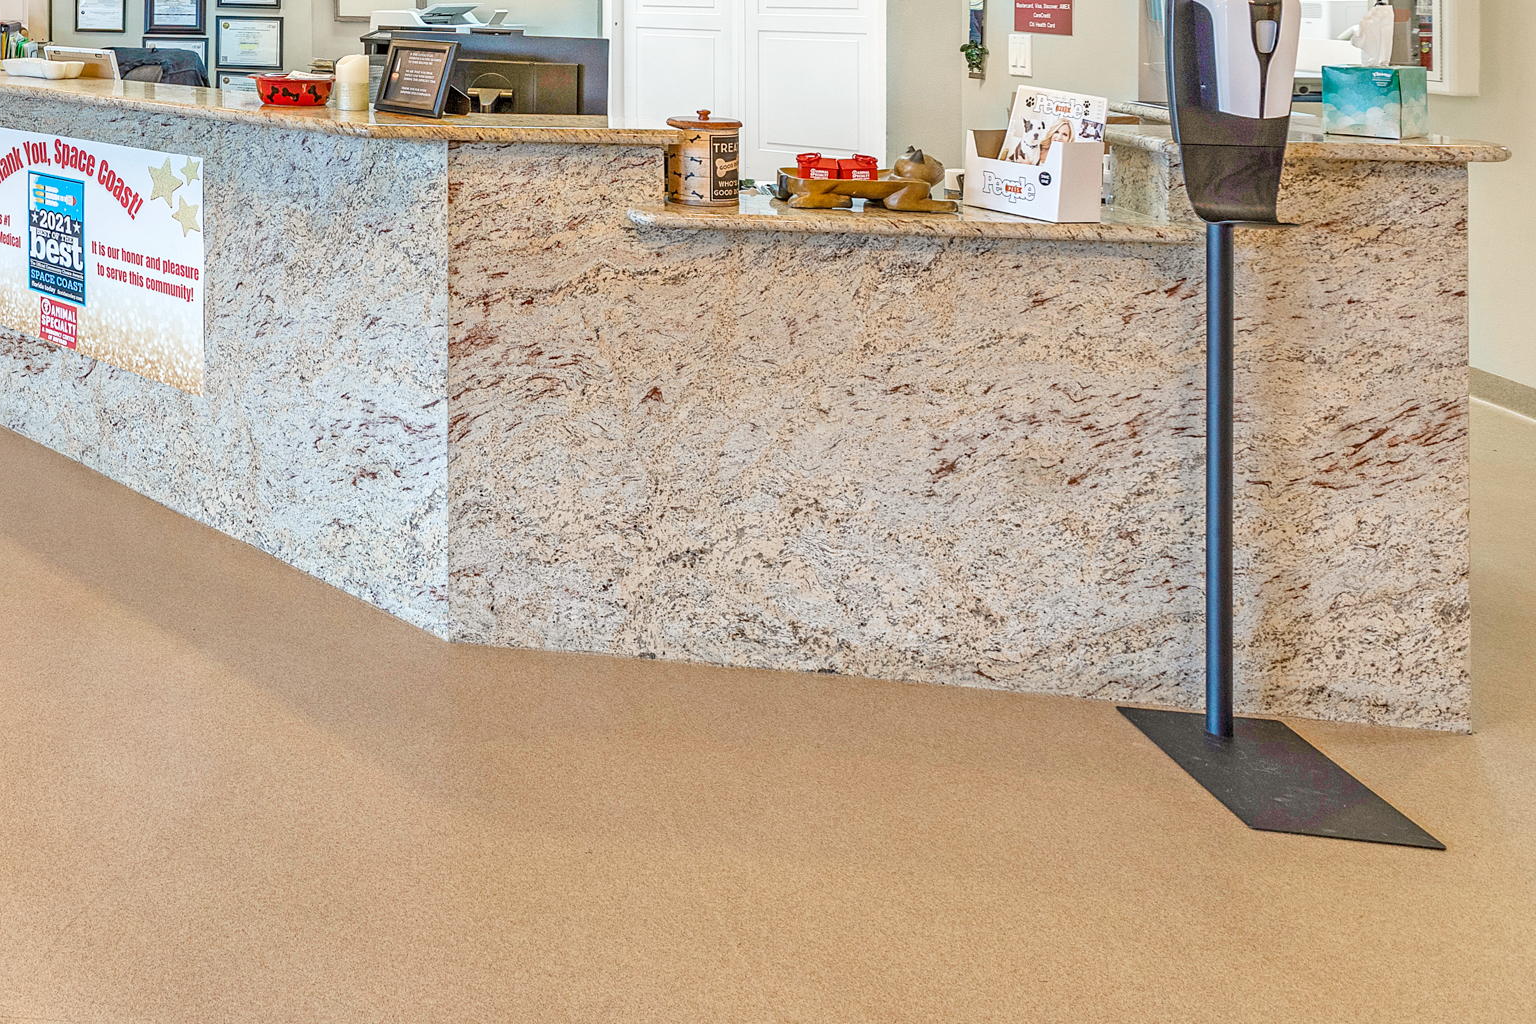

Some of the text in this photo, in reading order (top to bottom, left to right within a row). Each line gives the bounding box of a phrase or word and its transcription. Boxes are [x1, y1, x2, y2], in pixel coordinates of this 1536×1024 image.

[1033, 93, 1084, 119] People
[713, 143, 739, 153] TREA
[23, 141, 51, 166] You,
[54, 138, 95, 176] Space
[97, 159, 143, 220] Coast!
[983, 171, 1036, 203] People
[4, 214, 10, 227] #1
[39, 209, 72, 234] 2021
[37, 228, 73, 243] BEST OF THE
[30, 226, 83, 271] best
[91, 240, 199, 281] It is our honor and pleasure
[30, 269, 83, 293] SPACE COAST
[97, 262, 194, 303] to serve this community!
[41, 314, 76, 336] SPECIALTY
[51, 305, 76, 323] ANIMAL
